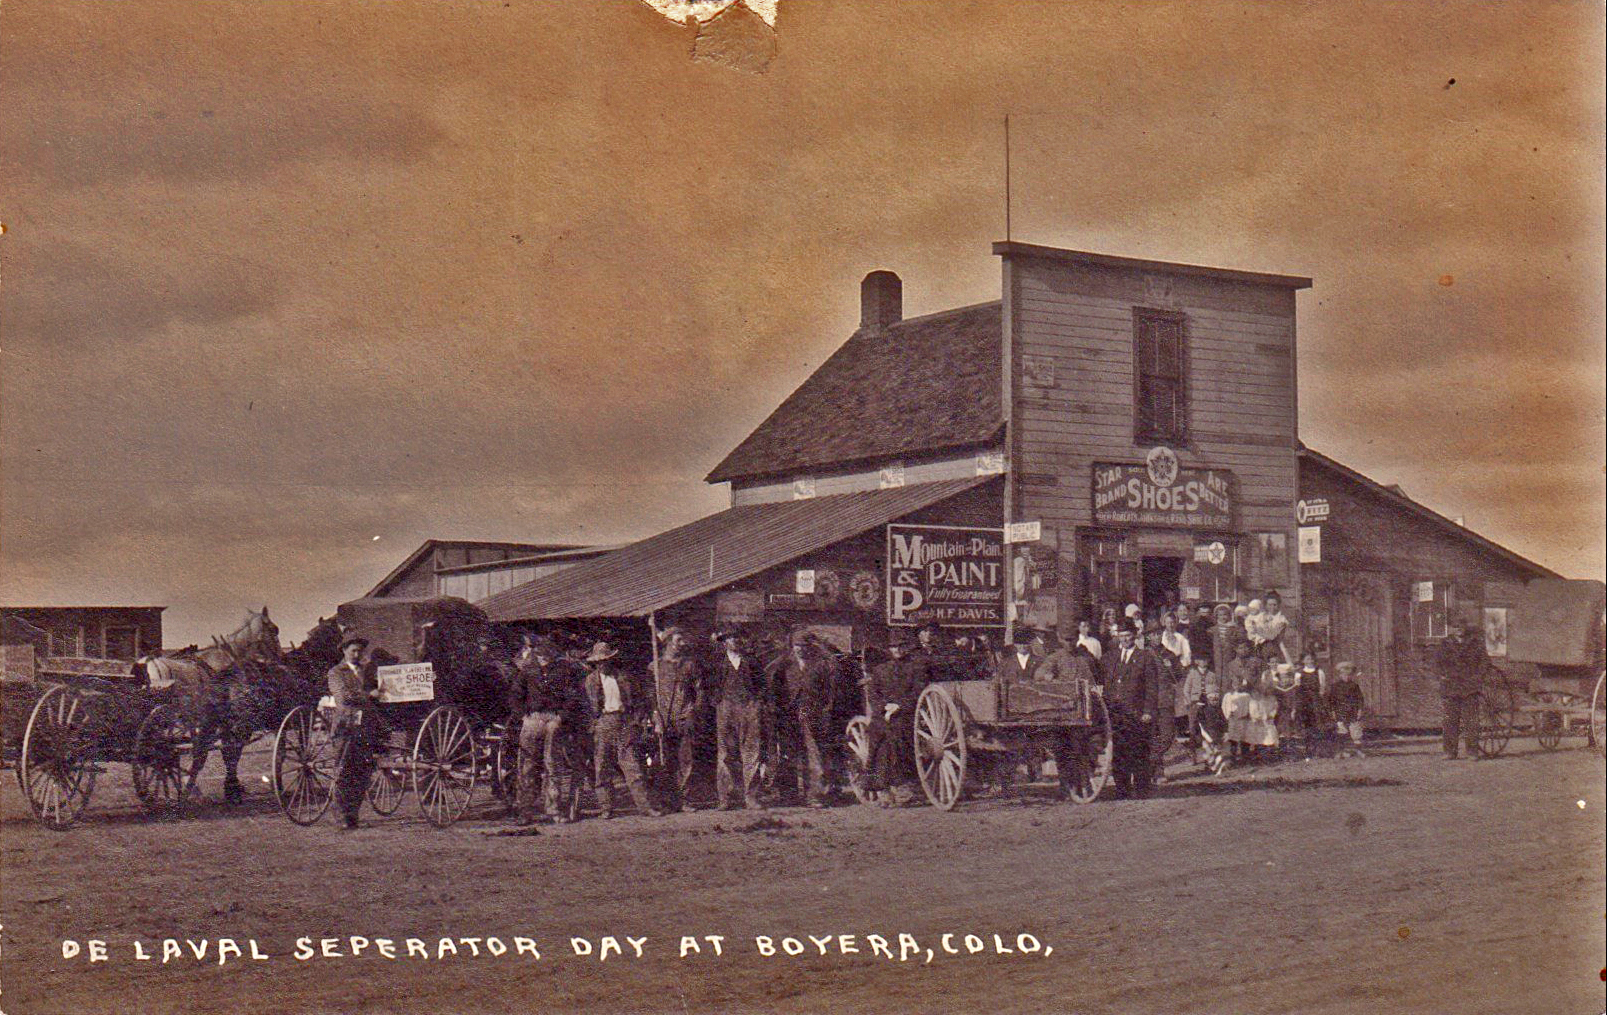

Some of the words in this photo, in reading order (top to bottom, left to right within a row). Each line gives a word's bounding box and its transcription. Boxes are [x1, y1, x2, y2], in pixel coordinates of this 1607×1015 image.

[1095, 466, 1122, 488] STAR
[1207, 471, 1228, 496] ARE
[1095, 484, 1127, 509] BRAND
[1128, 478, 1199, 511] SHOES
[1199, 482, 1229, 513] BETTER
[897, 571, 919, 586] &
[928, 561, 1000, 587] PAINT
[928, 588, 951, 601] Fully
[951, 588, 1002, 601] Guaranteed
